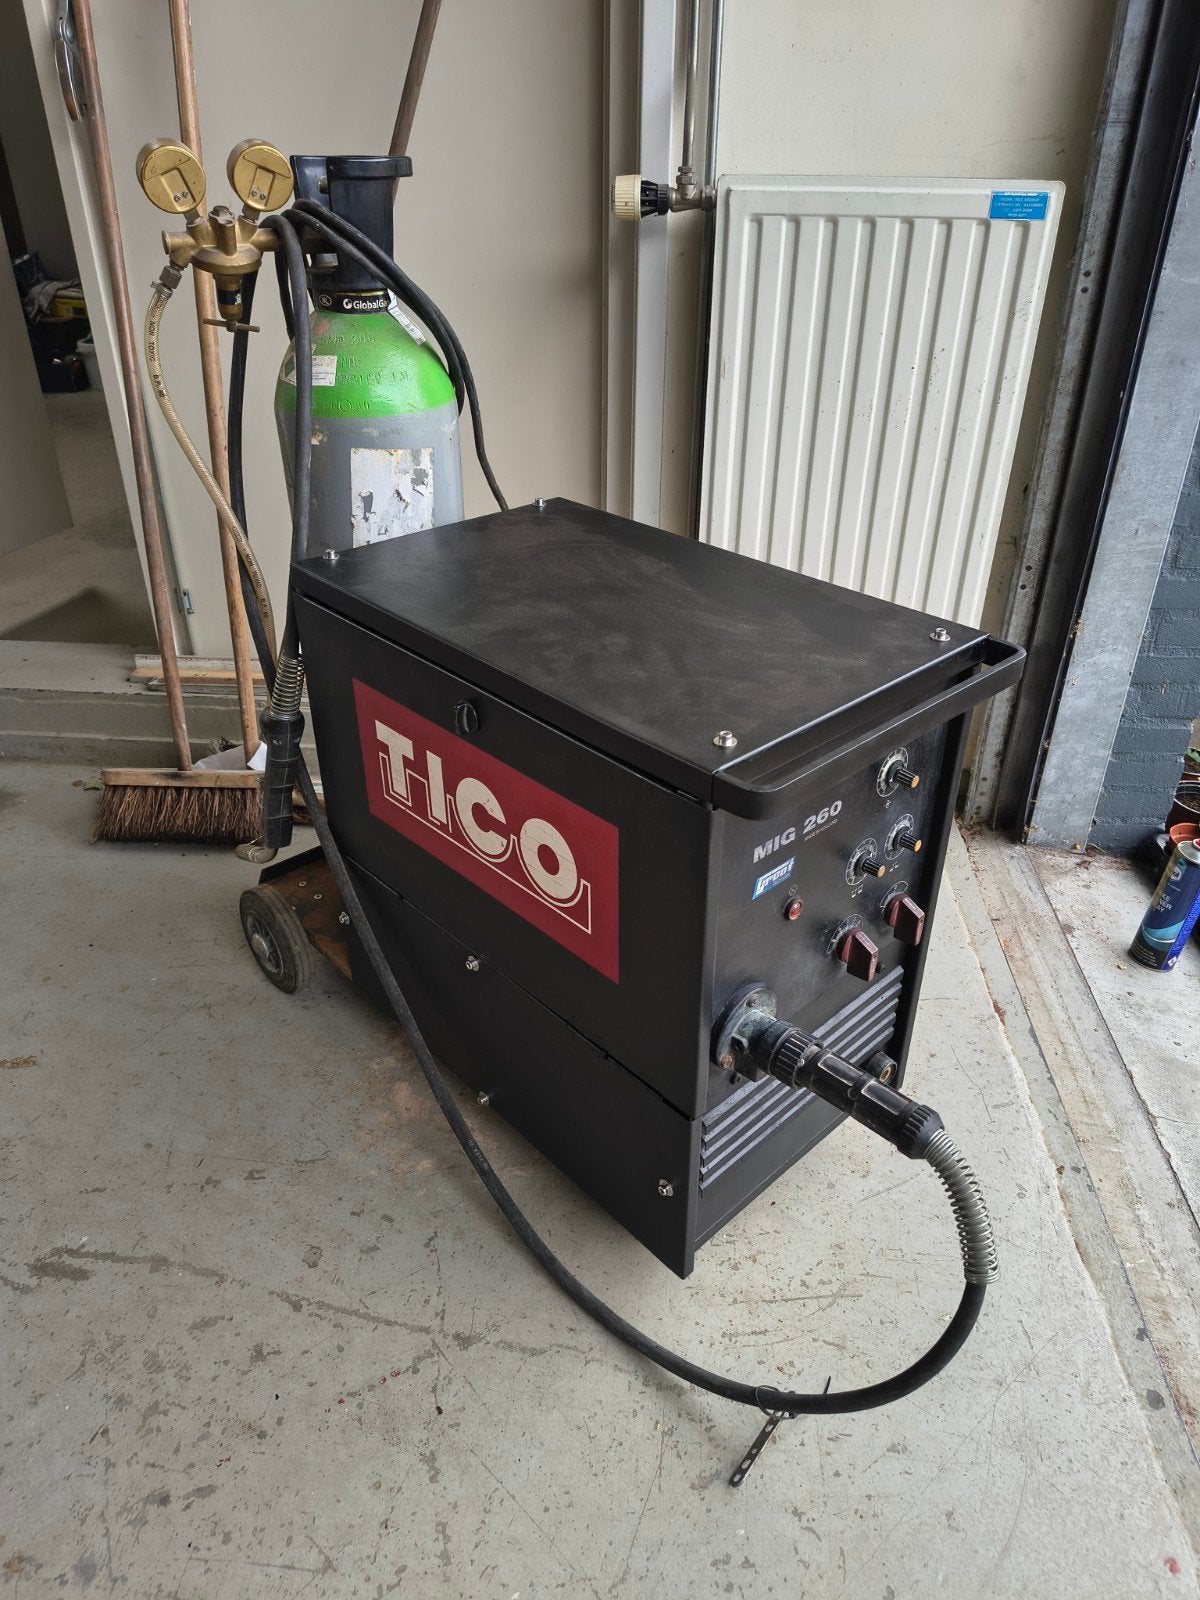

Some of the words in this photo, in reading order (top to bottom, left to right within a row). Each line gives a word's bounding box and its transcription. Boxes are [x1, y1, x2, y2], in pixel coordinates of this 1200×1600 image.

[375, 719, 578, 901] TICO
[753, 827, 796, 864] MIG
[802, 800, 843, 834] 260
